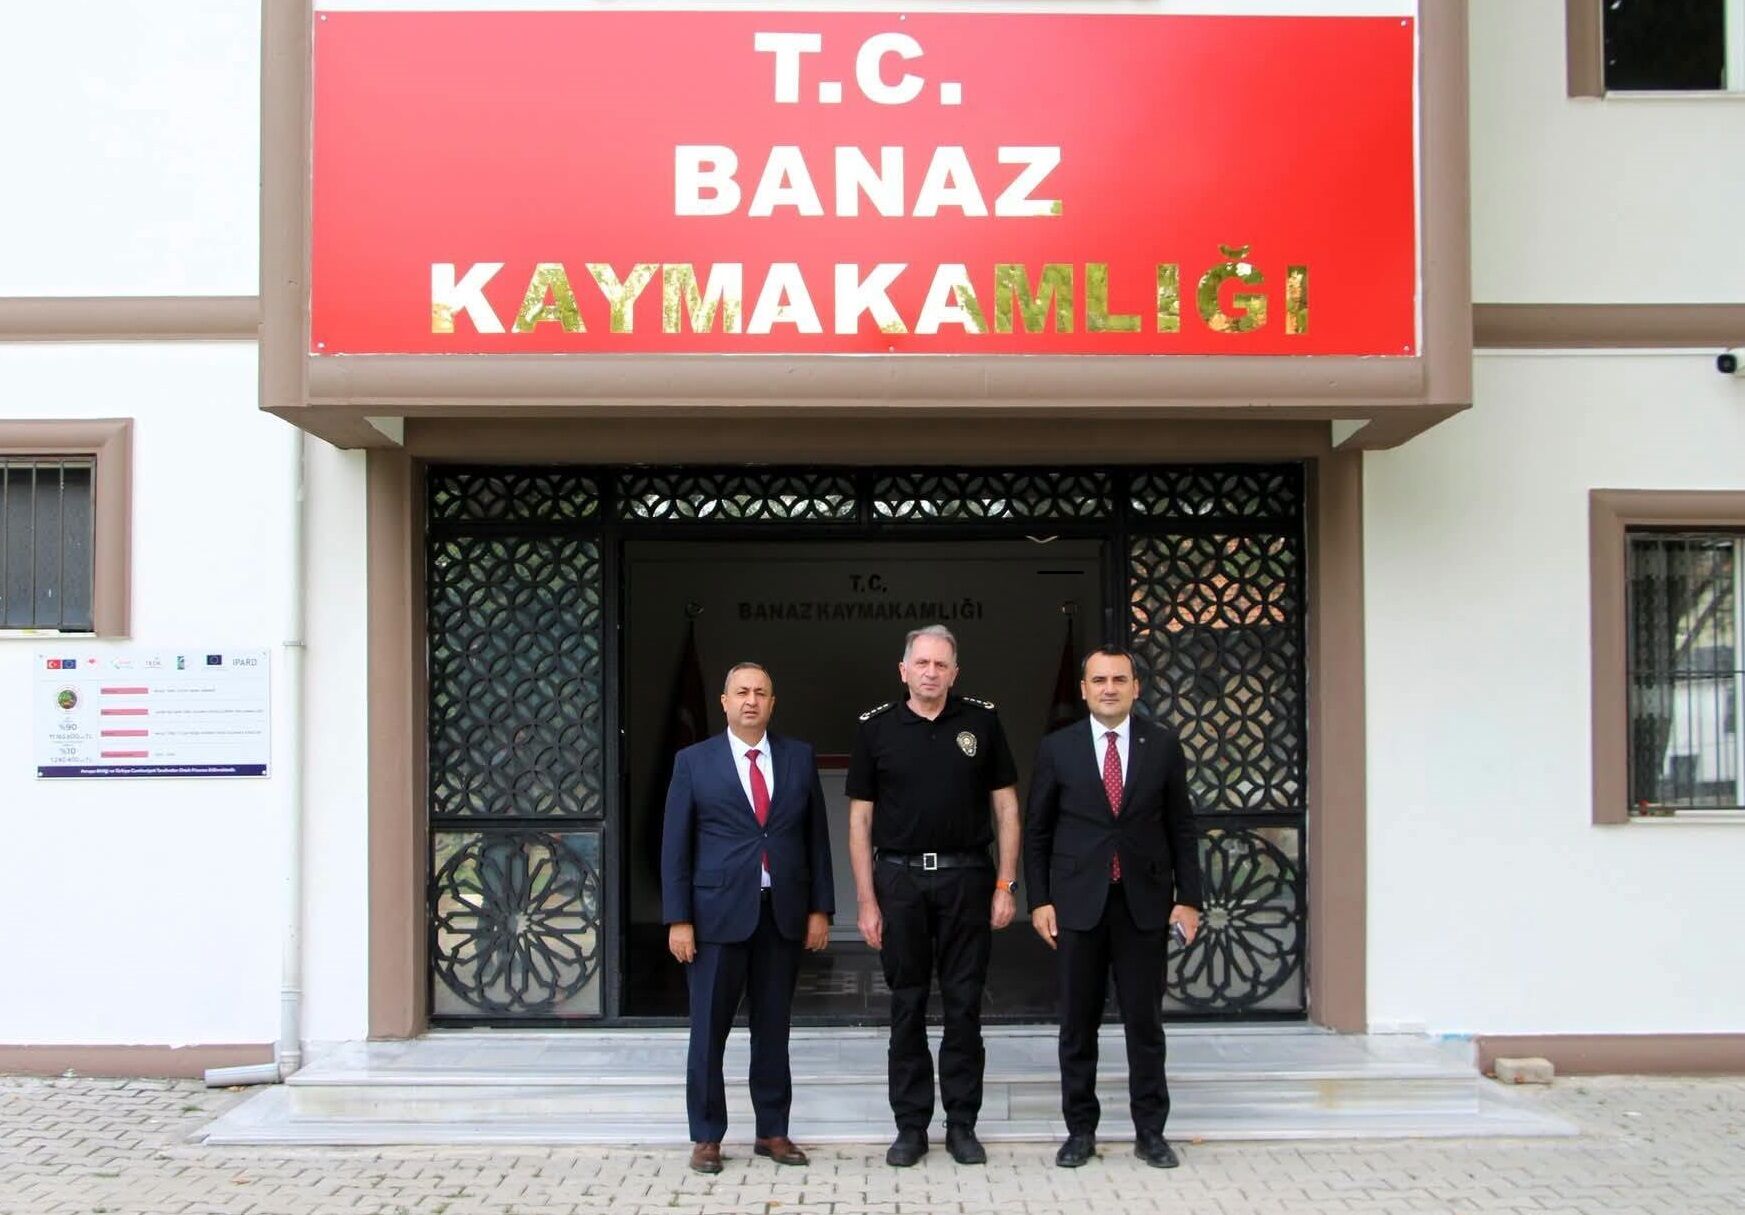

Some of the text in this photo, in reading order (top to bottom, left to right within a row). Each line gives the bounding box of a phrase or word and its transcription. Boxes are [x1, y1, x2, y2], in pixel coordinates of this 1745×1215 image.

[755, 32, 962, 105] T.C.
[674, 145, 1062, 217] BANAZ
[430, 245, 1309, 335] KAYMAKAMLIĞI
[849, 574, 889, 593] T.C.
[738, 602, 812, 621] BANAZ
[816, 598, 983, 621] KAYMAKAMLIĞI
[232, 658, 258, 667] IPARD
